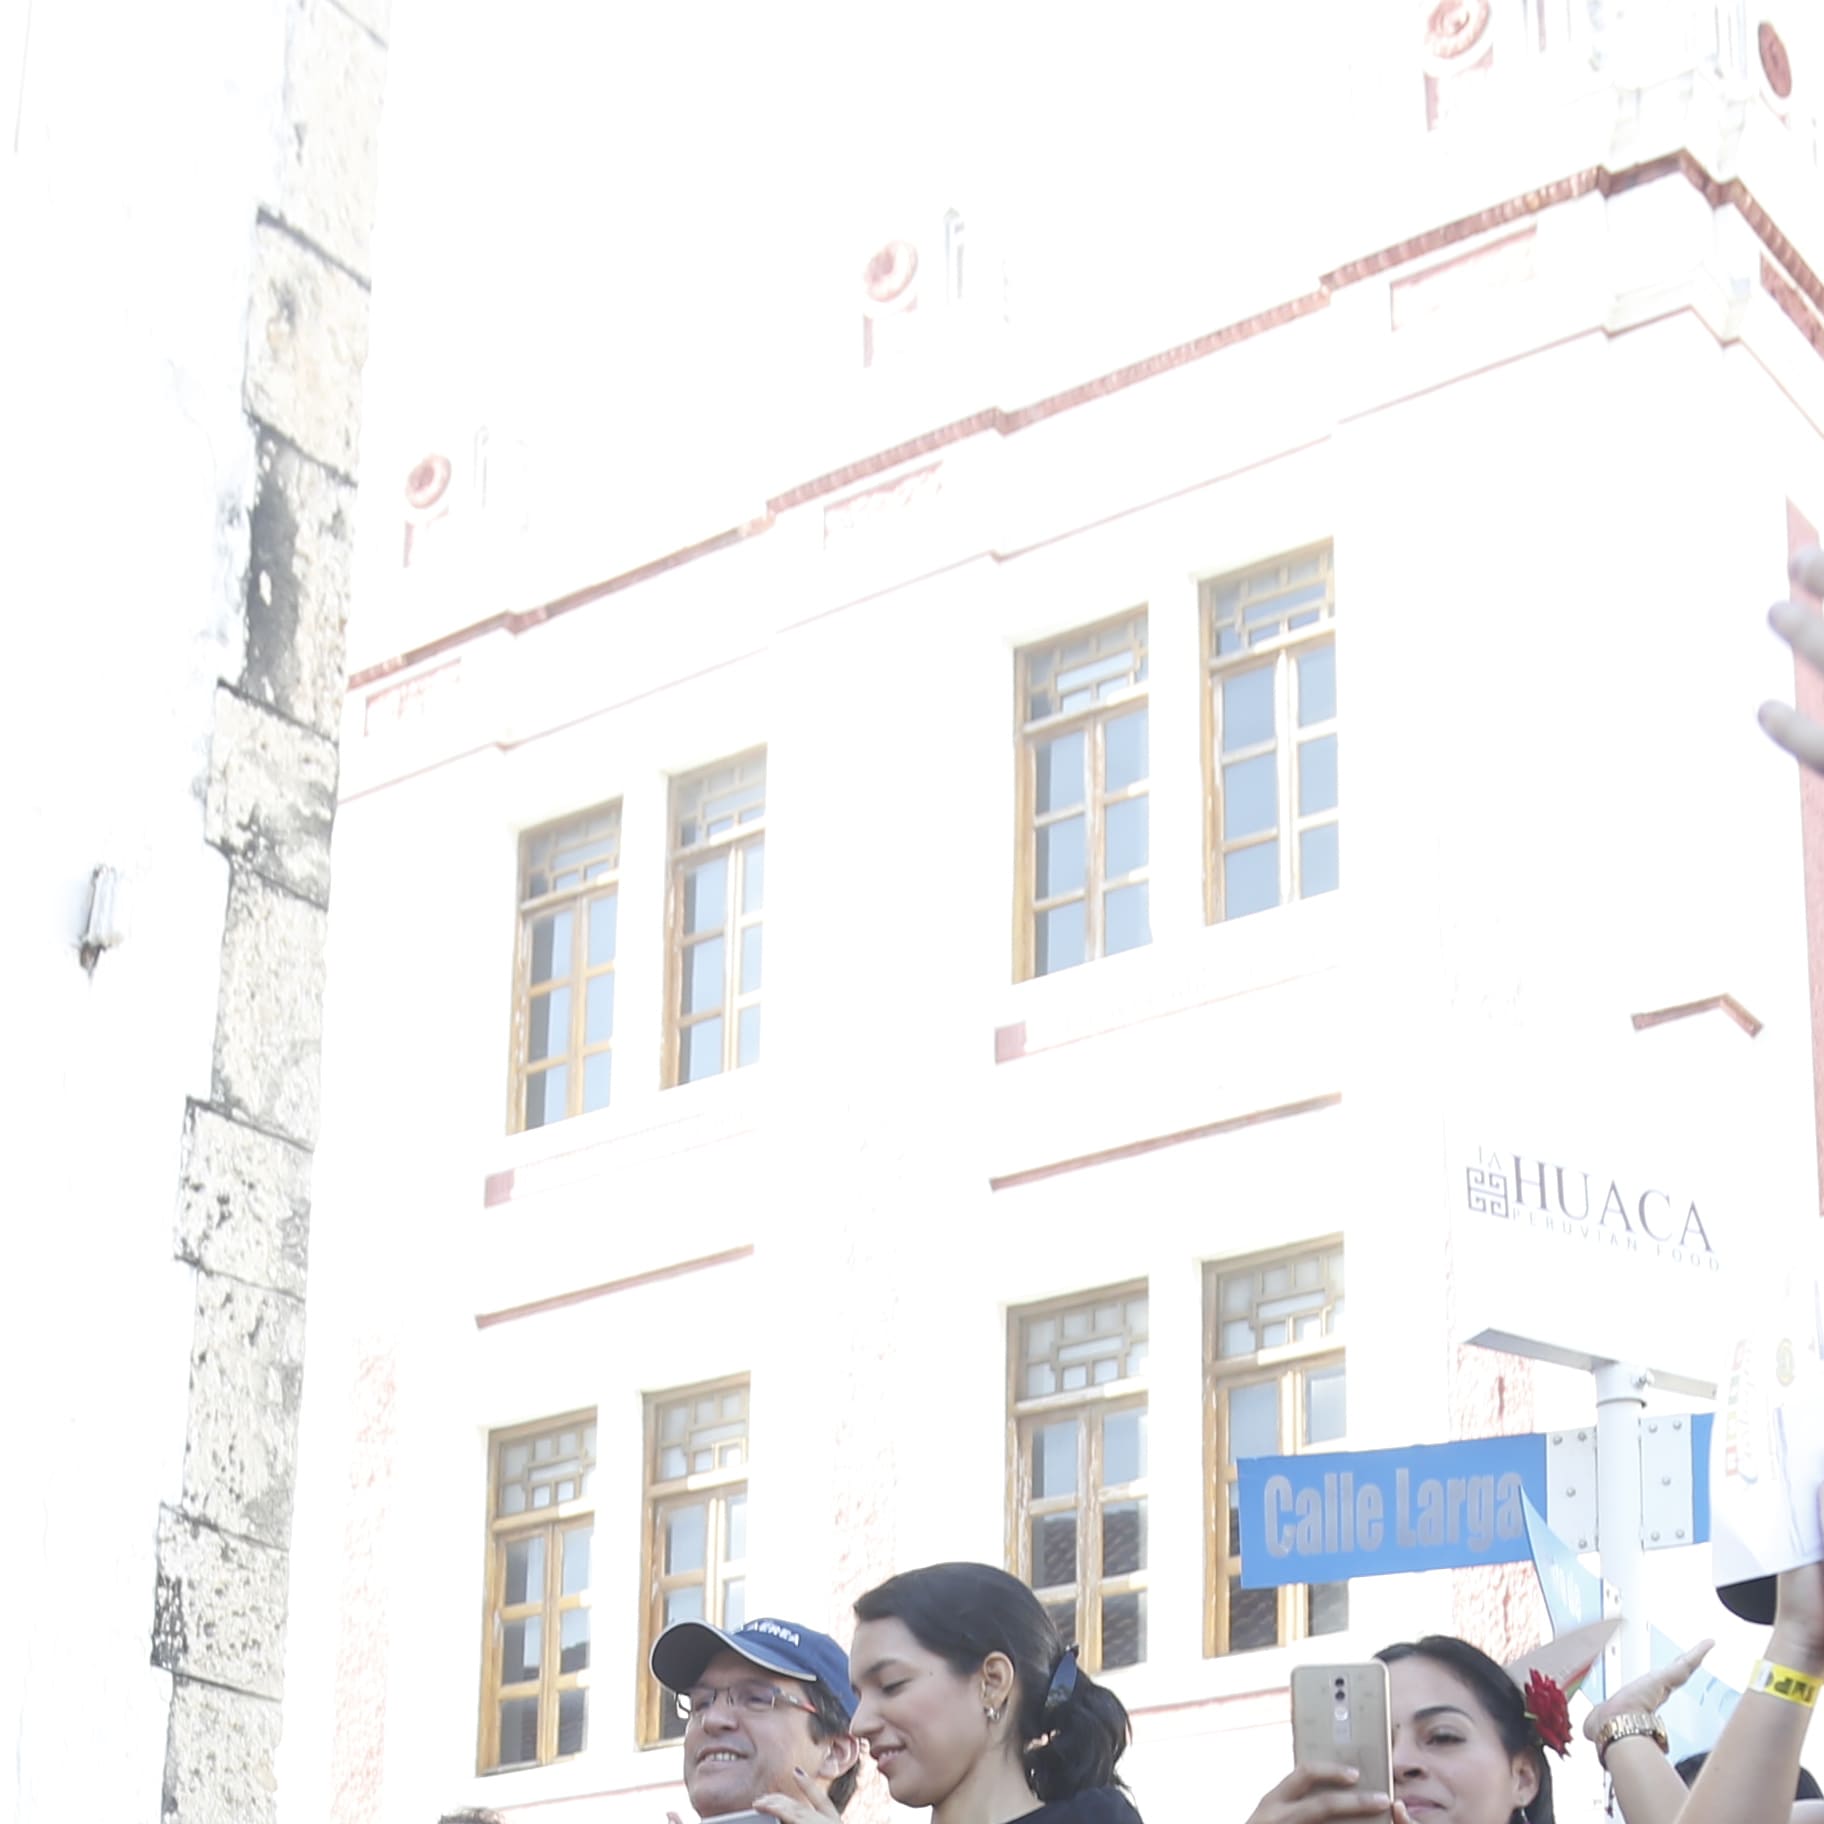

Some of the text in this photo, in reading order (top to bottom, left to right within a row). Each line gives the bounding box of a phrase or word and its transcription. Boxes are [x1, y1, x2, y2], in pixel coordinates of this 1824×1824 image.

[1509, 1152, 1715, 1255] HUACA
[1511, 1206, 1722, 1273] PERUVIAN FOOD
[1264, 1467, 1524, 1558] Calle Larga
